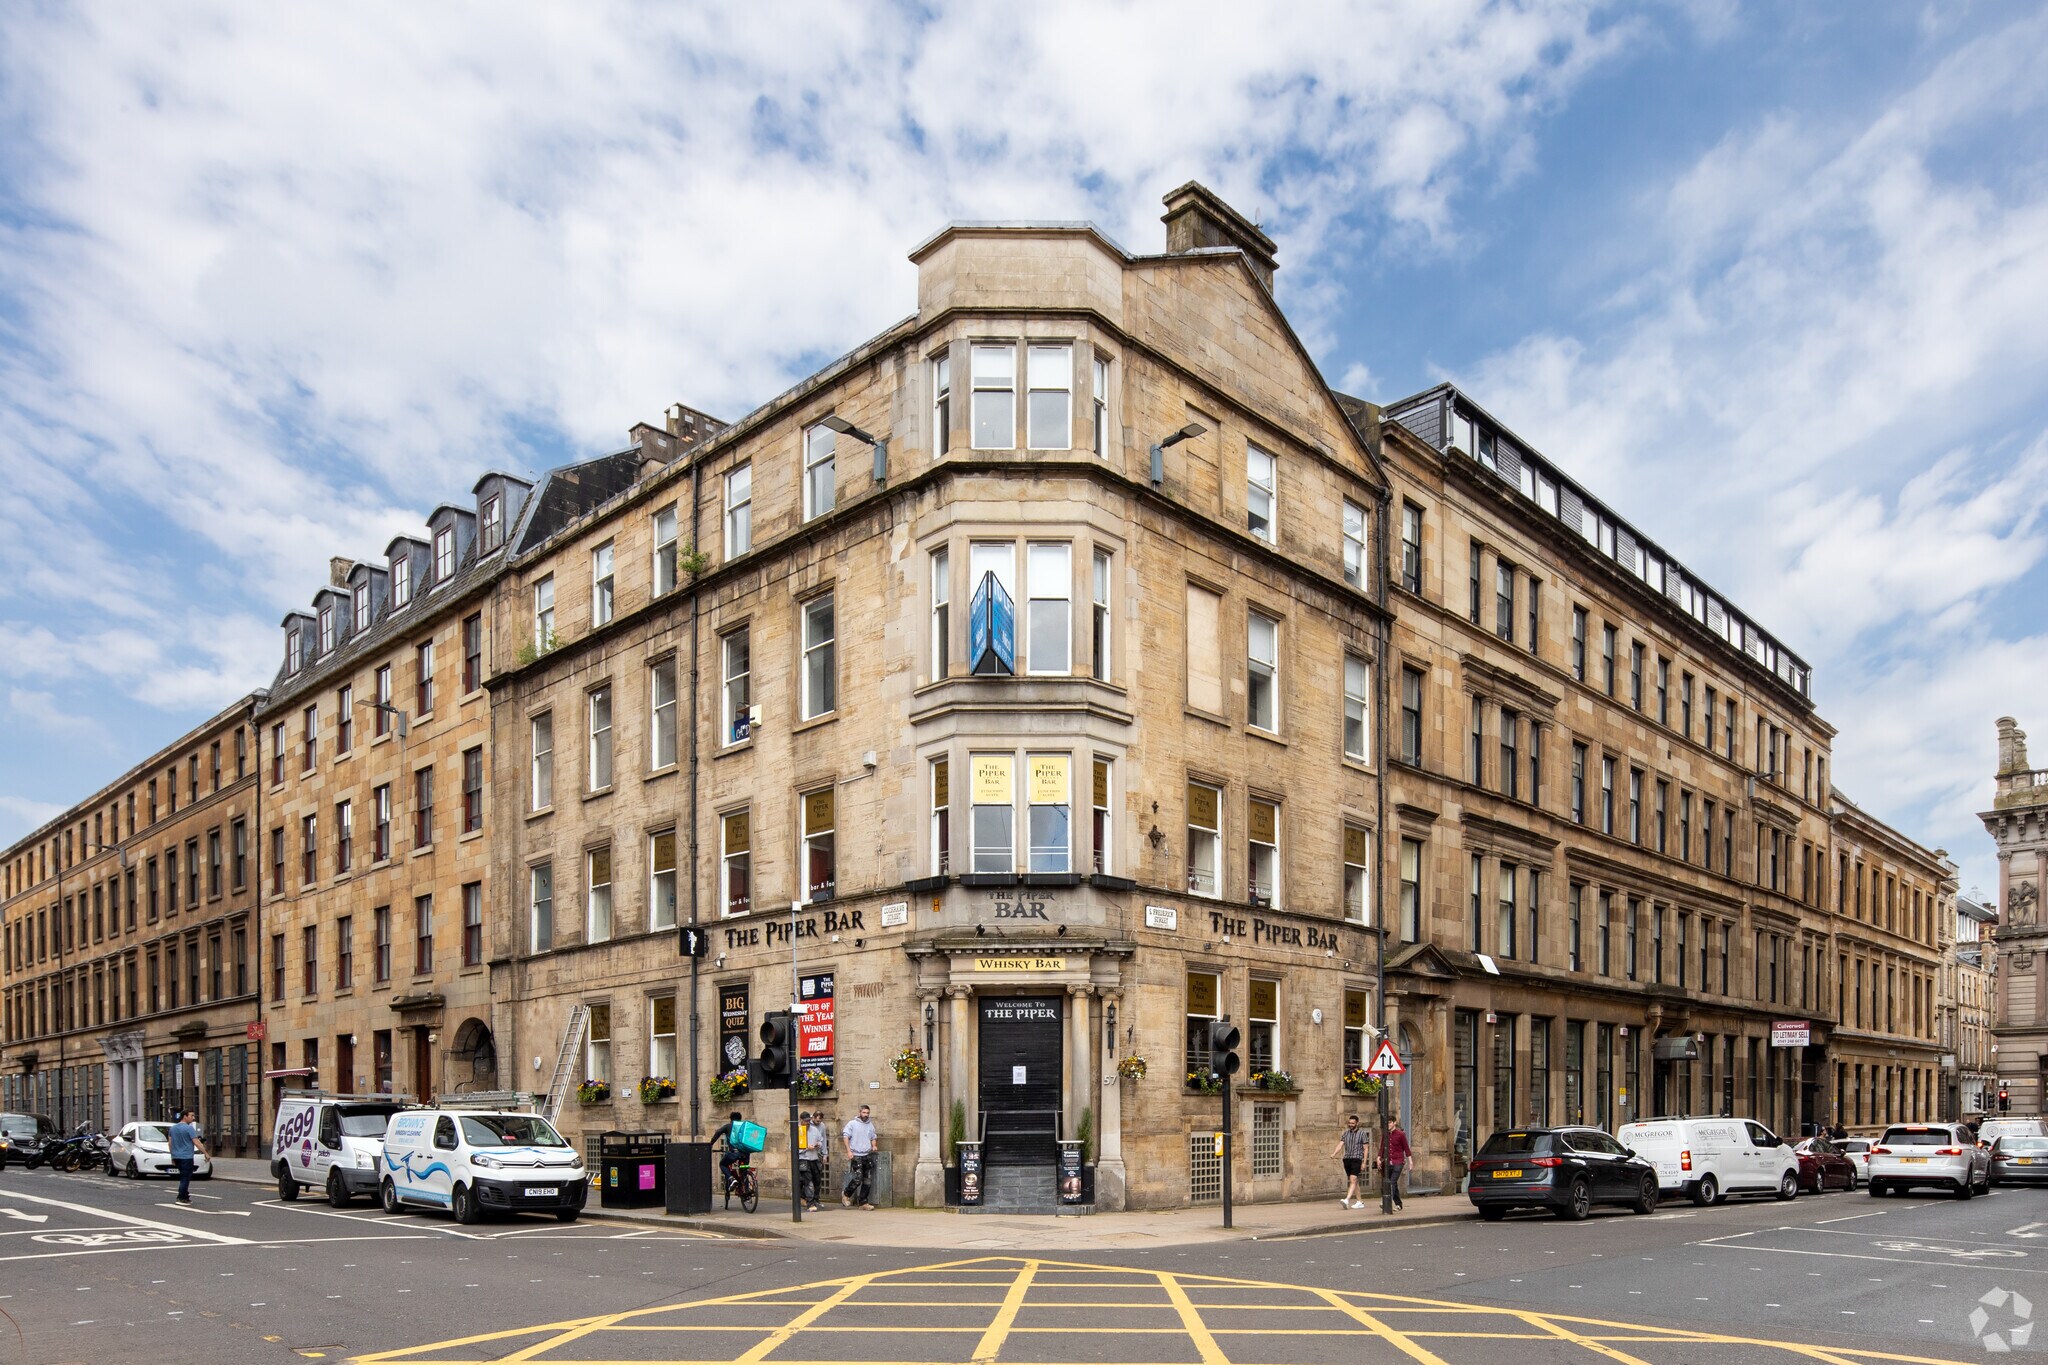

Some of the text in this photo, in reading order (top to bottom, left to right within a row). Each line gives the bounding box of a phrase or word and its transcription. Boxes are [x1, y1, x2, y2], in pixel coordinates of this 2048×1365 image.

[979, 770, 1005, 778] PIPER
[1036, 770, 1062, 778] PIPER
[985, 890, 1056, 901] THE PIPER
[994, 902, 1050, 921] BAR
[725, 910, 865, 949] THE PIPER BAR
[1209, 911, 1340, 952] THE PIPER BAR
[979, 960, 1061, 970] WHISKY BAR
[725, 997, 745, 1010] BIG
[806, 1002, 831, 1011] PUB OF
[722, 1010, 748, 1018] WEDNESDAY
[800, 1014, 814, 1022] THE
[985, 1009, 1056, 1019] THE PIPER
[725, 1017, 745, 1028] QUIZ
[802, 1024, 833, 1033] WINNER
[808, 1036, 828, 1051] mail
[1103, 1075, 1117, 1085] 57
[398, 1117, 426, 1128] BROWN'S
[276, 1106, 315, 1155] £699
[302, 1148, 312, 1157] FREE
